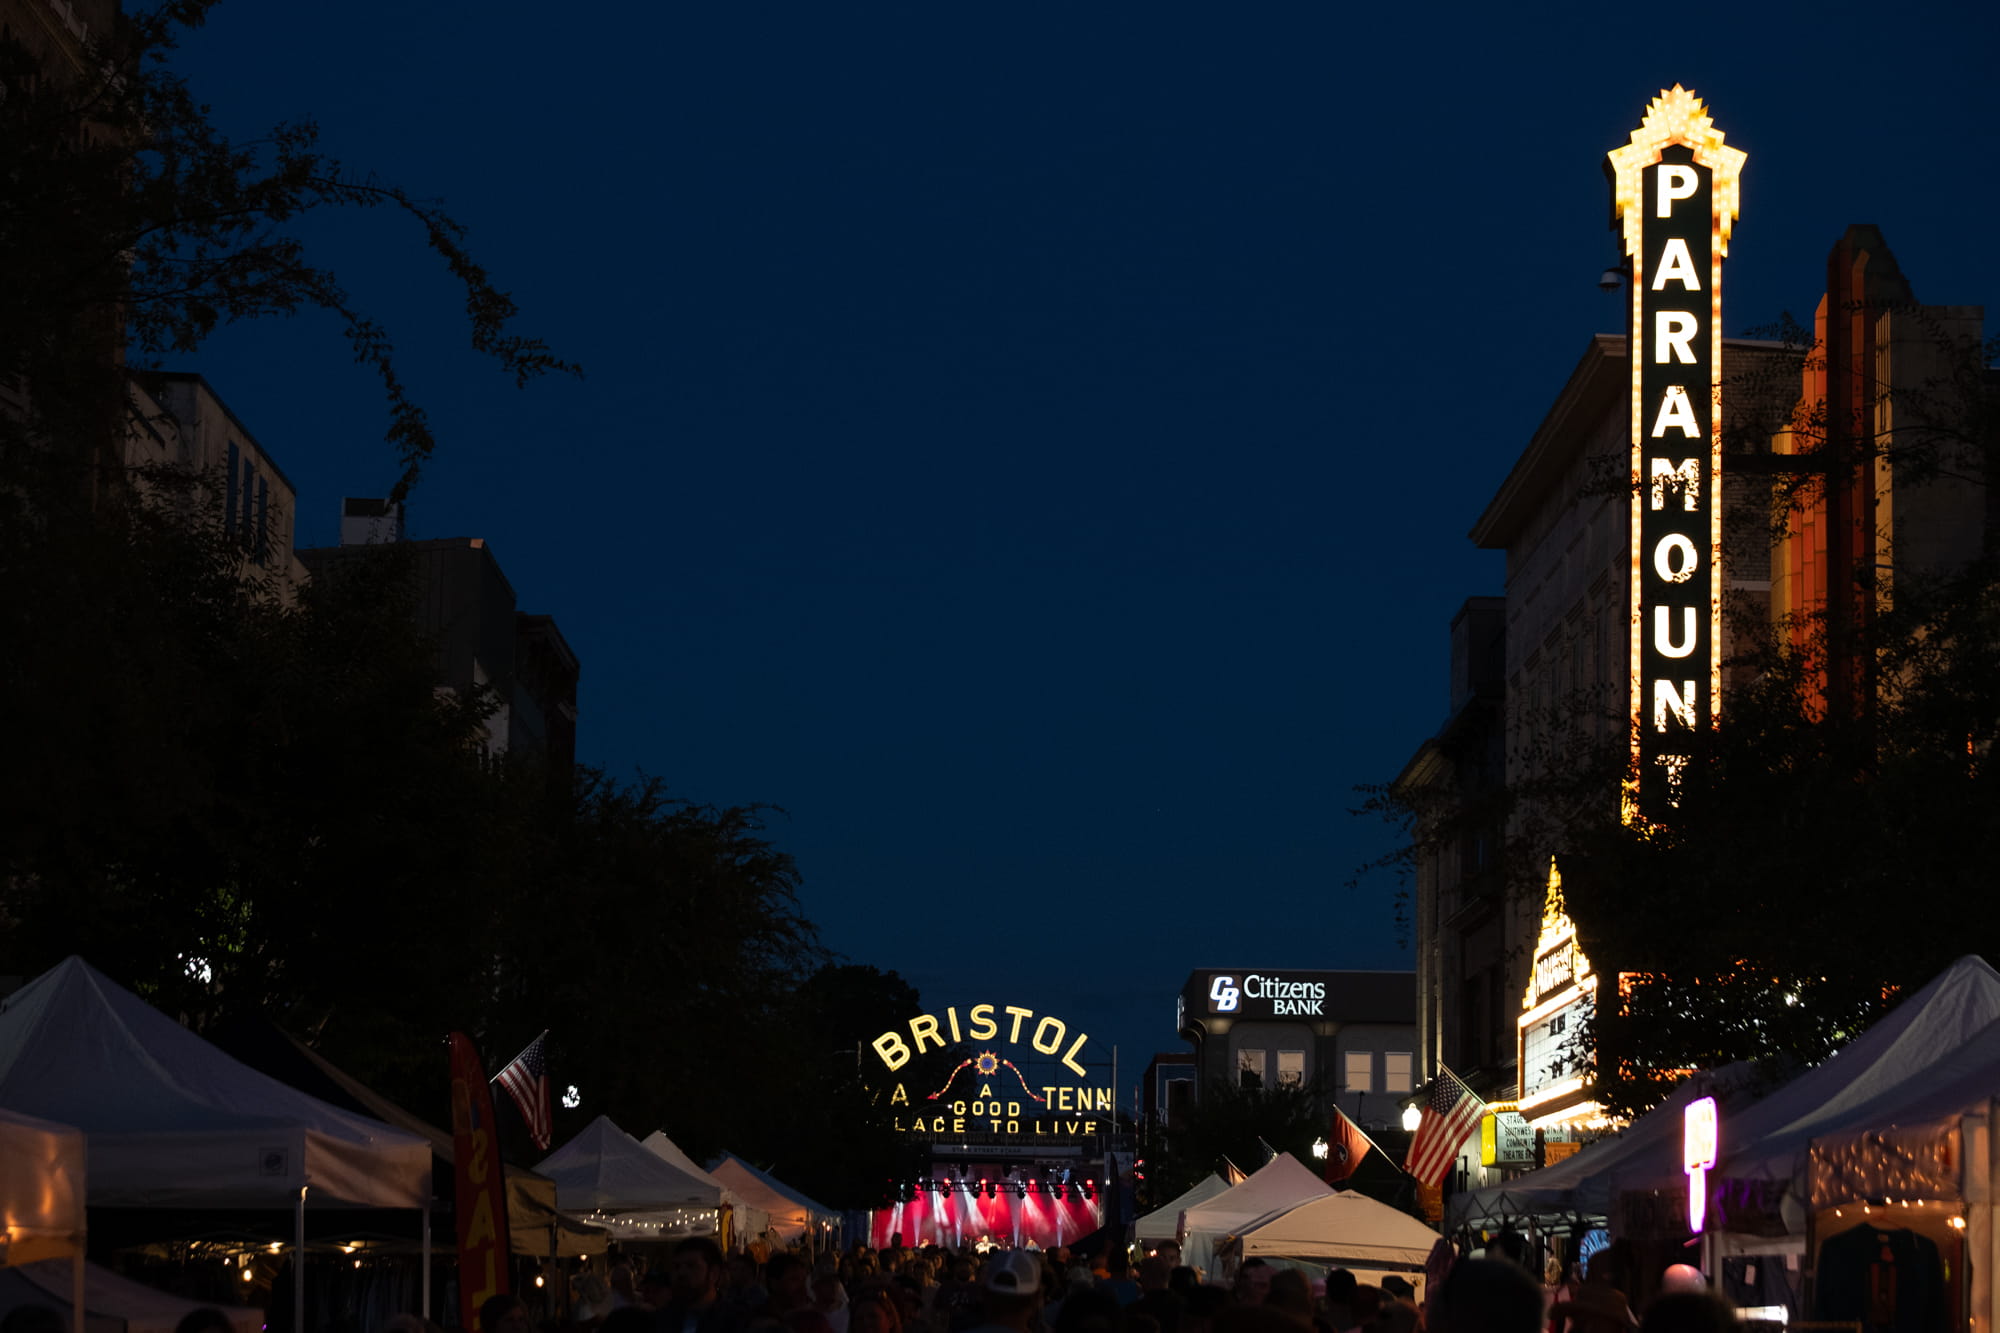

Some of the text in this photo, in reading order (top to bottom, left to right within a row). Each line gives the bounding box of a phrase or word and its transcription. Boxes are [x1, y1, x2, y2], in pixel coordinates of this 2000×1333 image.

[1651, 164, 1701, 808] PARAMOUNT
[1243, 974, 1326, 999] Citizens
[1273, 1000, 1324, 1016] BANK
[872, 1003, 1089, 1078] BRISTOL
[980, 1084, 993, 1098] A
[1042, 1087, 1112, 1111] TENN
[953, 1100, 1021, 1117] GOOD
[894, 1117, 1097, 1136] LACE TO LIVE
